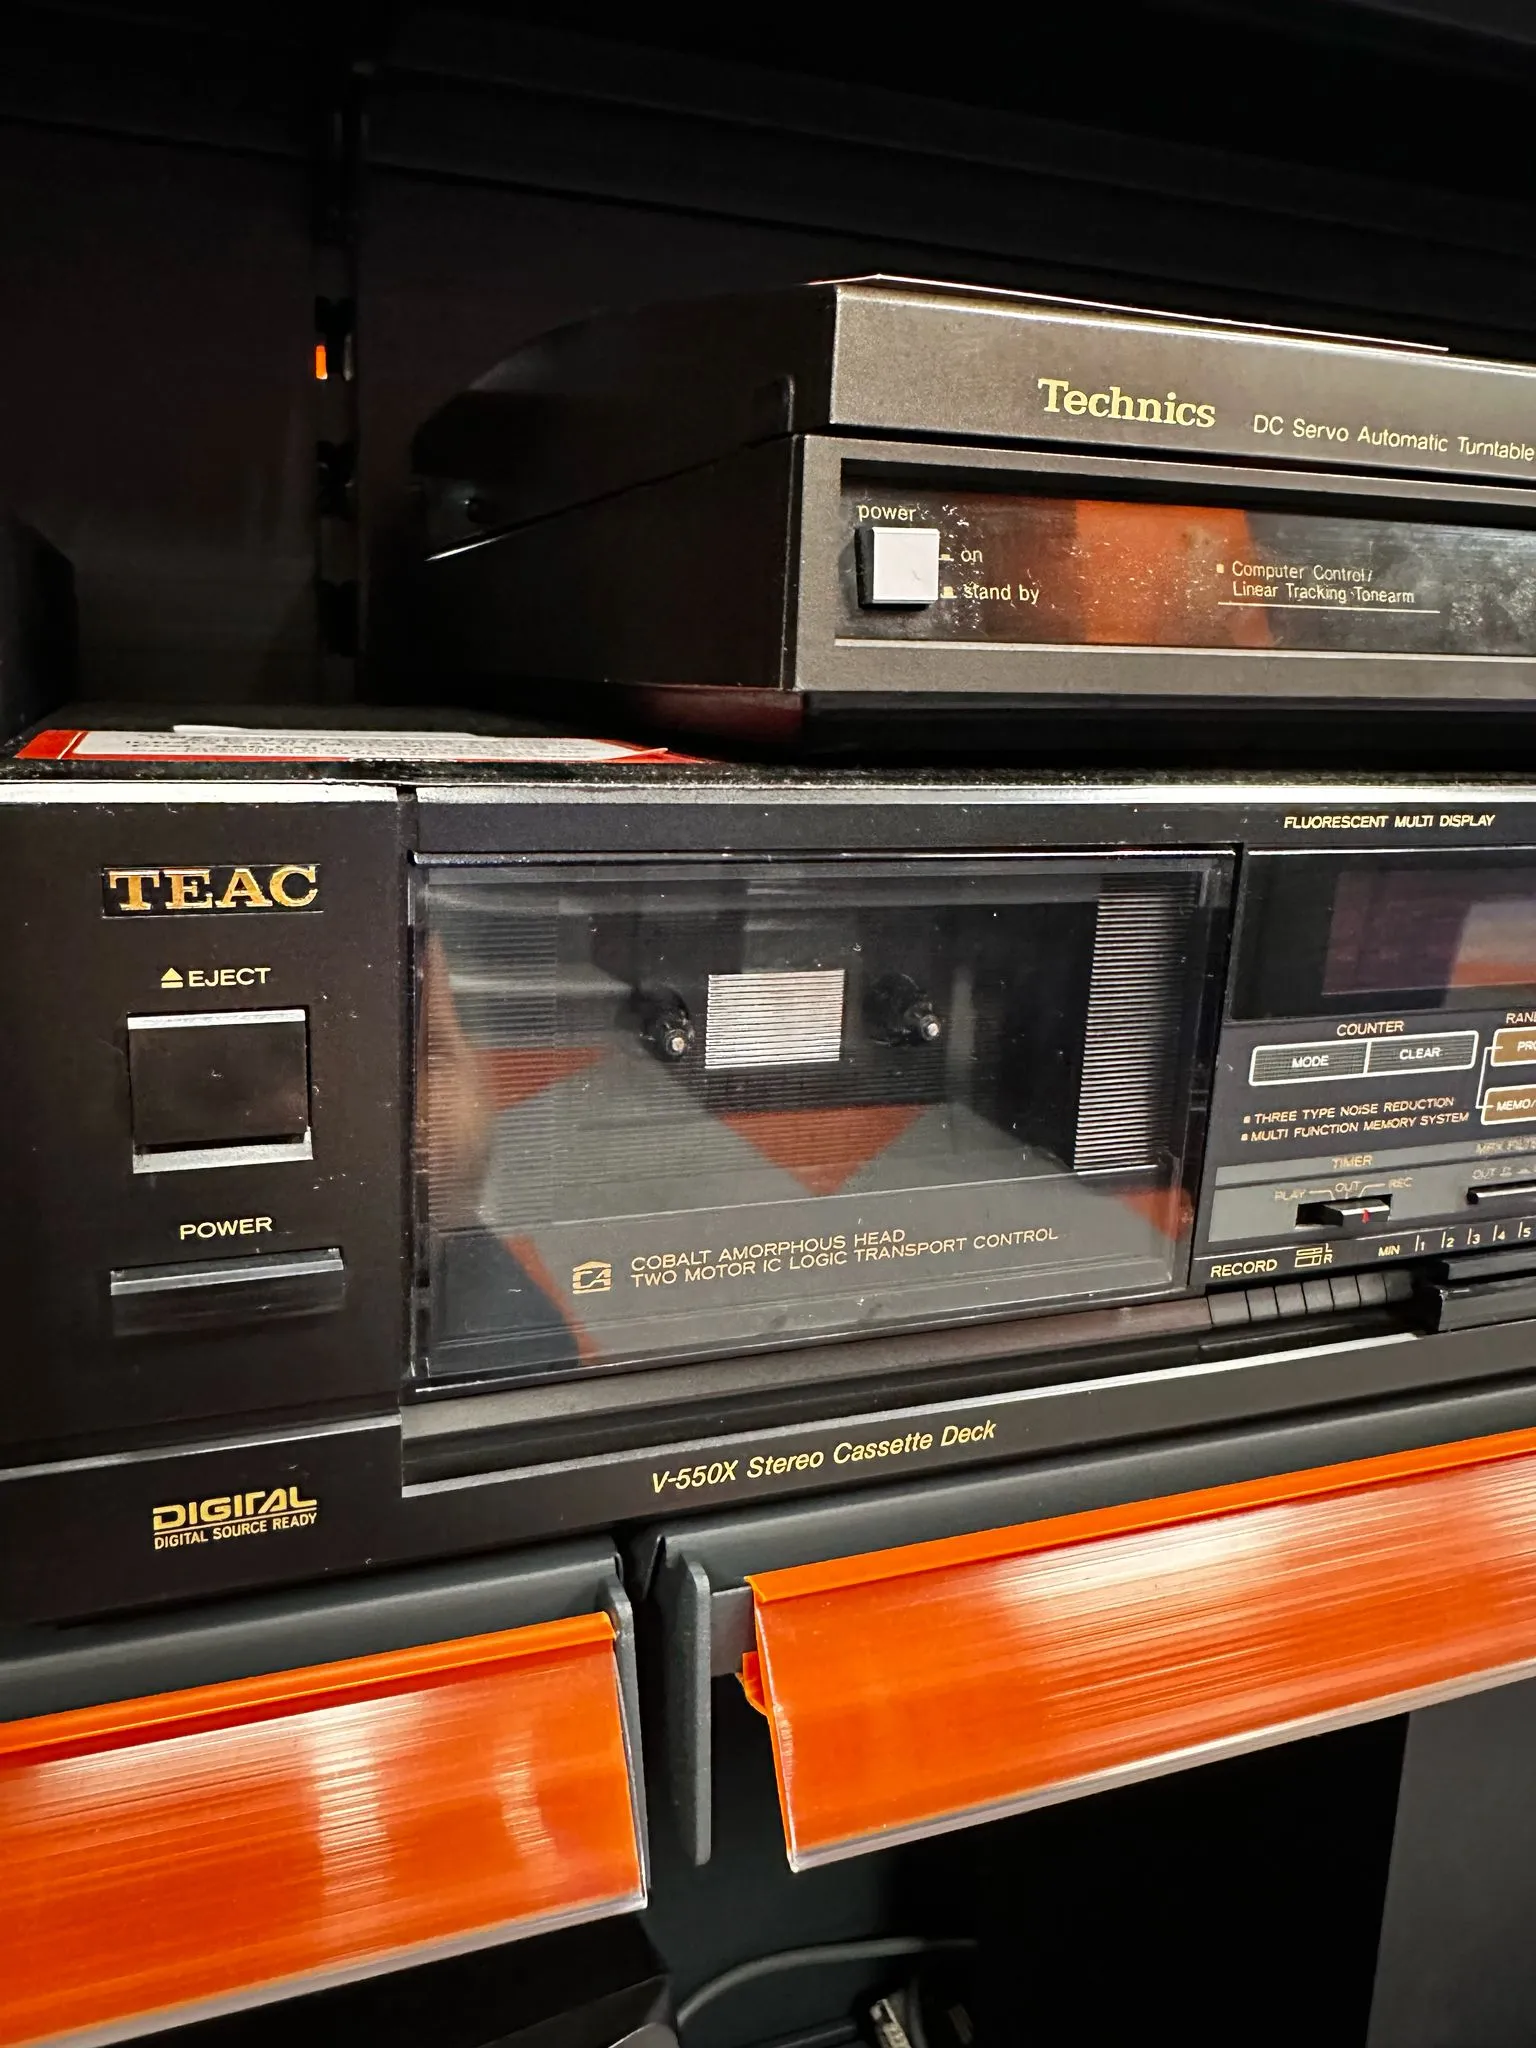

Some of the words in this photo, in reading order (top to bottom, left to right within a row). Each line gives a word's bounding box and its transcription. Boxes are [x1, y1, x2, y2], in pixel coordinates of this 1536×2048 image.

[1037, 377, 1216, 428] Technics
[1253, 414, 1284, 436] DC
[1292, 418, 1349, 443] Servo
[1357, 425, 1448, 452] Automatic
[1457, 436, 1534, 461] Turntable
[857, 503, 917, 522] power
[960, 549, 983, 563] on
[1231, 560, 1305, 581] Computer
[963, 583, 1011, 601] stand
[1018, 584, 1040, 605] by
[1232, 580, 1279, 598] Linear
[1285, 582, 1347, 605] Tracking
[1353, 585, 1415, 604] Tonearm
[1283, 815, 1389, 830] FLUORESCENT
[1394, 814, 1434, 828] MULTI
[1439, 814, 1496, 828] DISPLAY
[108, 865, 319, 911] TEAC
[188, 967, 271, 988] EJECT
[1505, 1011, 1536, 1024] RAN
[1336, 1020, 1405, 1037] COUNTER
[1290, 1055, 1330, 1069] MODE
[1399, 1046, 1441, 1061] CLEAR
[1254, 1110, 1297, 1124] THREE
[1302, 1107, 1335, 1120] TYPE
[1340, 1103, 1378, 1116] NOISE
[1383, 1097, 1455, 1113] REDUCTION
[1250, 1128, 1289, 1142] MULTI
[1293, 1122, 1359, 1138] FUNCTION
[1363, 1117, 1416, 1131] MEMORY
[1419, 1112, 1469, 1126] SYSTEM
[1332, 1154, 1373, 1169] TIMER
[180, 1216, 272, 1240] POWER
[630, 1248, 712, 1272] COBALT
[718, 1234, 846, 1262] AMORPHOUS
[853, 1228, 906, 1248] HEAD
[630, 1268, 678, 1288] TWO
[684, 1261, 756, 1282] MOTOR
[762, 1256, 783, 1273] IC
[788, 1250, 848, 1271] LOGIC
[853, 1237, 968, 1264] TRANSPORT
[973, 1227, 1059, 1250] CONTROL
[1324, 1254, 1333, 1264] R
[1378, 1244, 1400, 1257] MIN
[1210, 1258, 1277, 1278] RECORD
[652, 1459, 739, 1494] V-550X
[746, 1451, 824, 1480] Stereo
[833, 1430, 933, 1465] Cassette
[941, 1419, 996, 1447] Deck
[152, 1485, 318, 1532] DIGITAL
[154, 1530, 209, 1551] DIGITAL
[212, 1520, 268, 1541] SOURCE
[272, 1511, 318, 1532] READY
